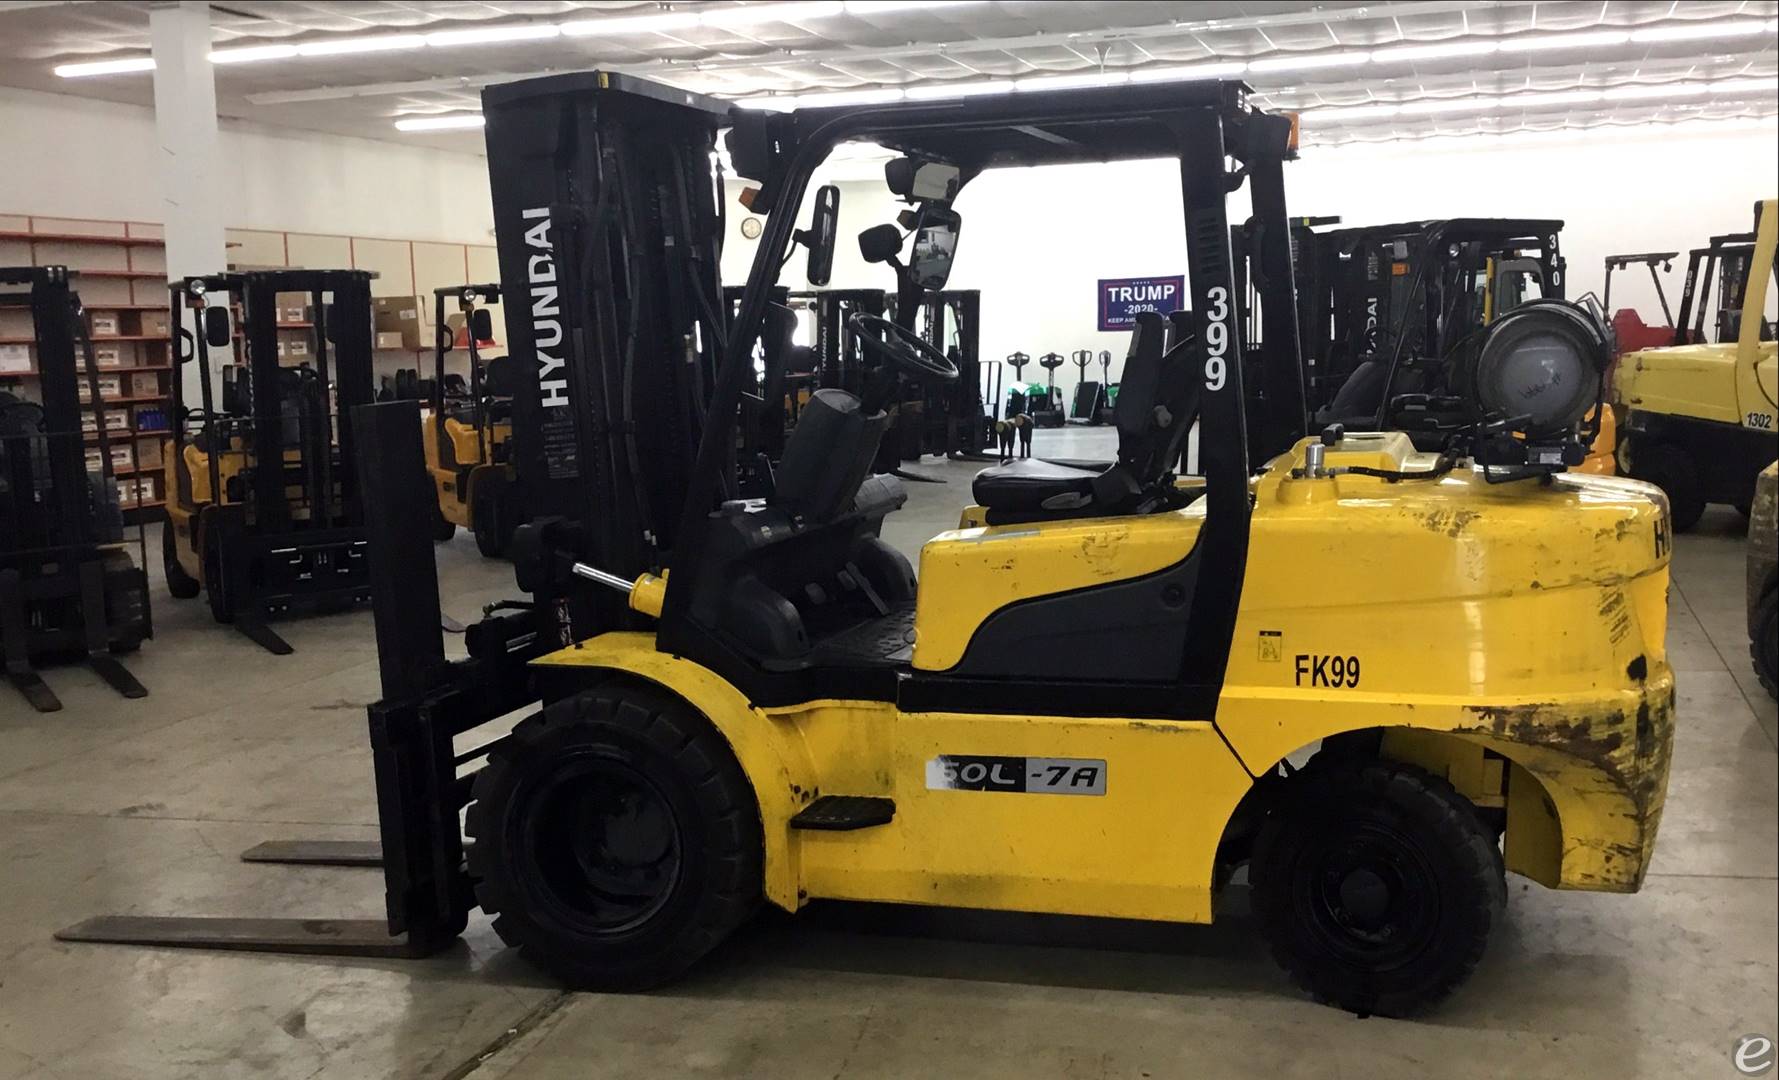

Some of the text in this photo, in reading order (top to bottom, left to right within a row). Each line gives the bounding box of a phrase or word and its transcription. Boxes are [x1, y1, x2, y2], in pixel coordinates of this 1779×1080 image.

[1549, 234, 1560, 286] 340
[522, 207, 569, 407] HYUNDAI
[1108, 285, 1175, 302] TRUMP
[1205, 286, 1228, 392] 399
[1747, 412, 1772, 429] 1302
[1295, 654, 1360, 688] FK99
